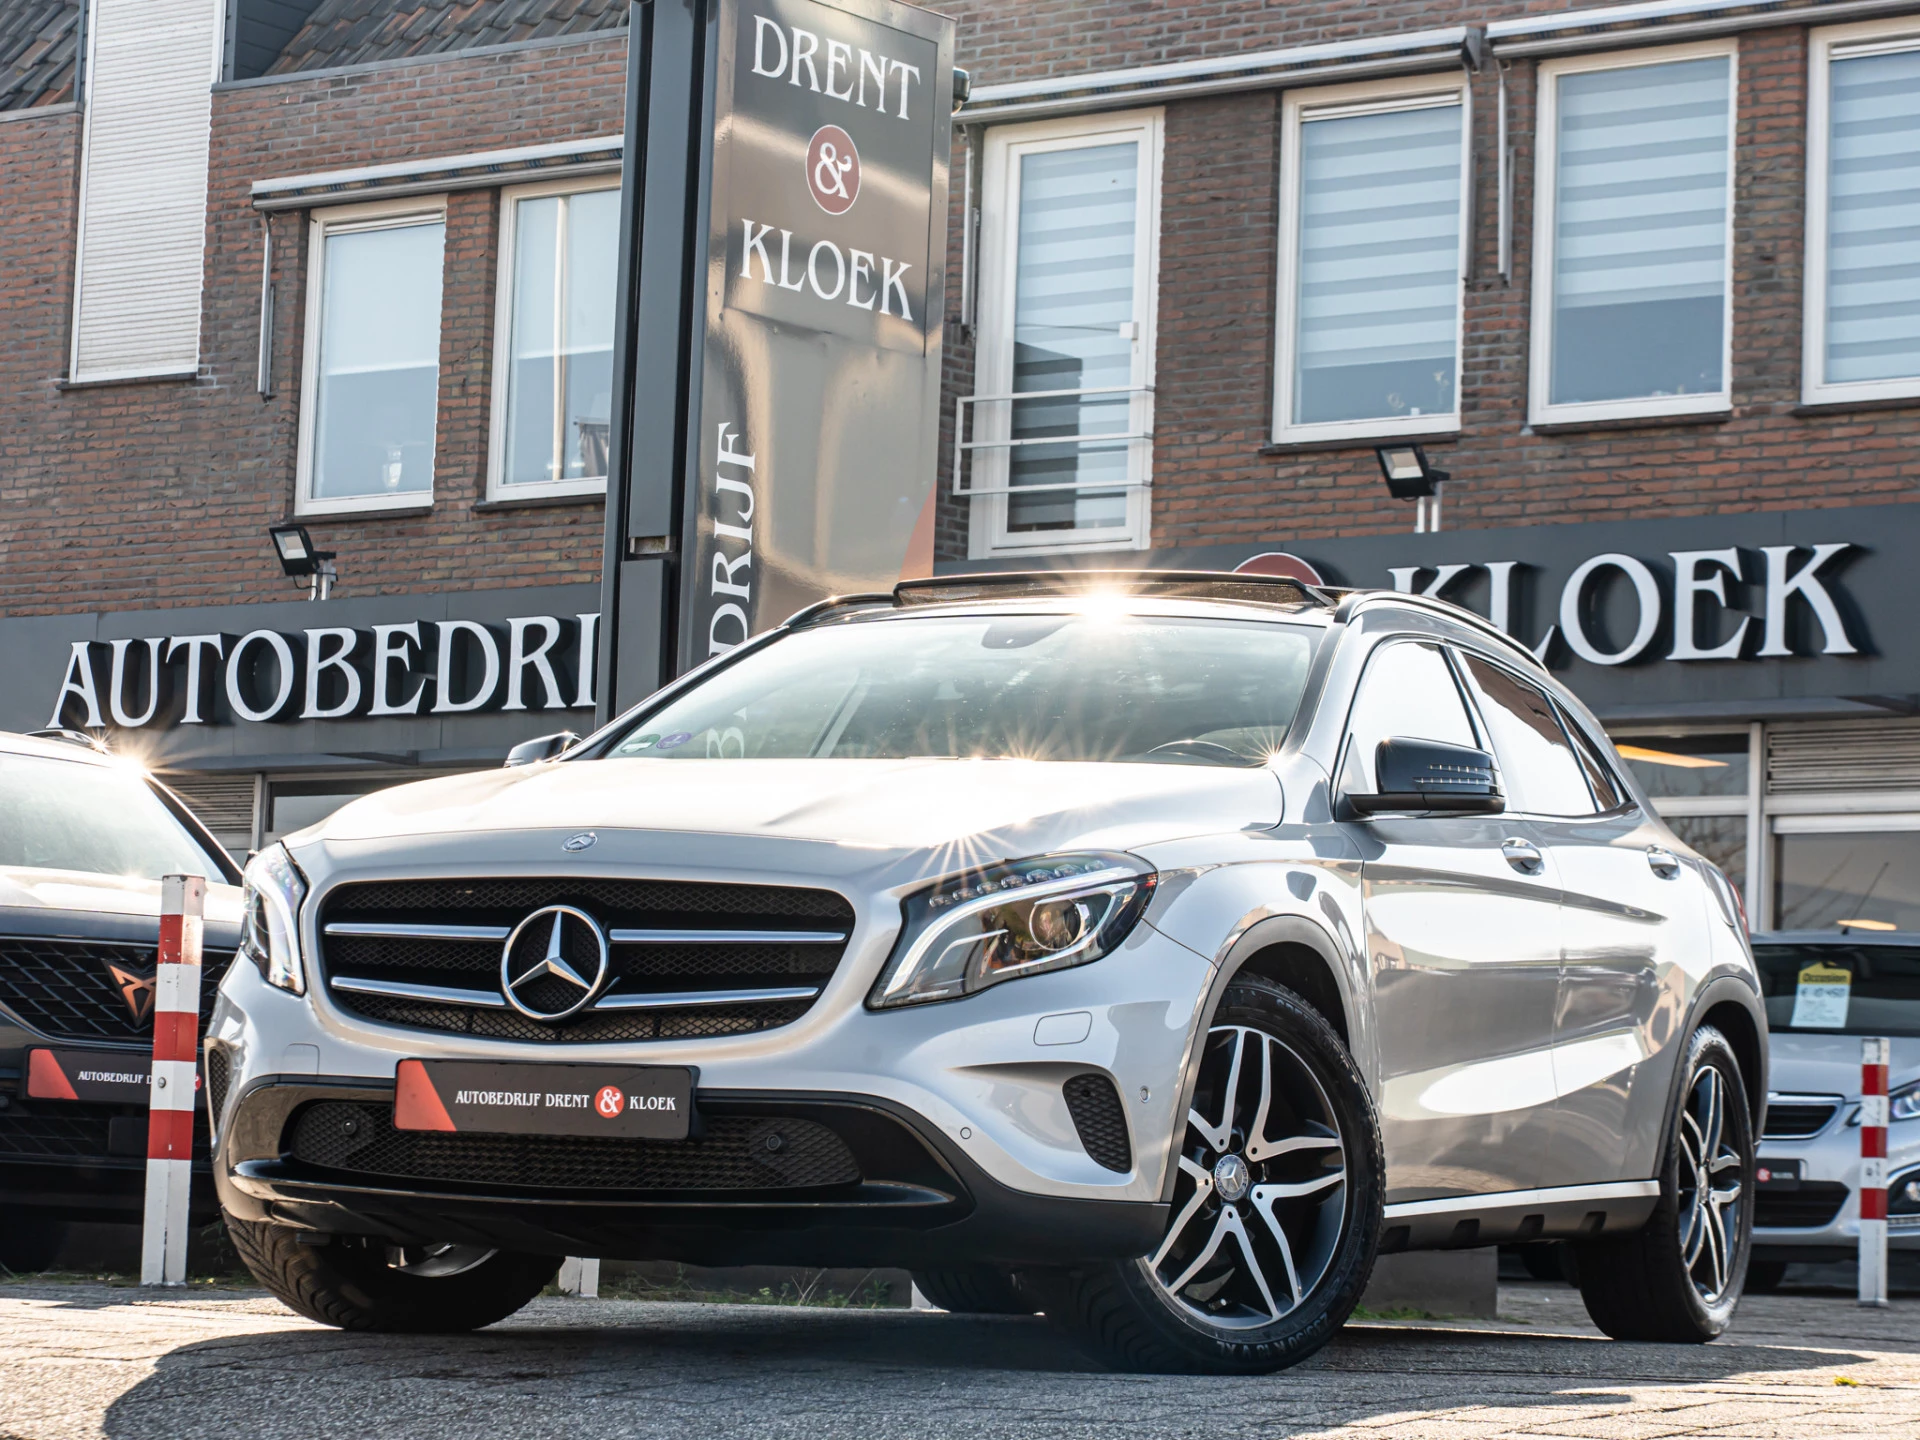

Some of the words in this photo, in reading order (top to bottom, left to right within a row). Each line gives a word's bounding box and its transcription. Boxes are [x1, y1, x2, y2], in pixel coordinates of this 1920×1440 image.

[751, 14, 921, 121] DRENT
[814, 142, 852, 200] &
[739, 218, 914, 322] KLOEK
[77, 1071, 143, 1084] AUTOBEDRIJF
[455, 1090, 542, 1107] AUTOBEDRIJF
[545, 1093, 590, 1108] DRENT
[600, 1089, 621, 1113] &
[629, 1095, 676, 1111] KLOEK
